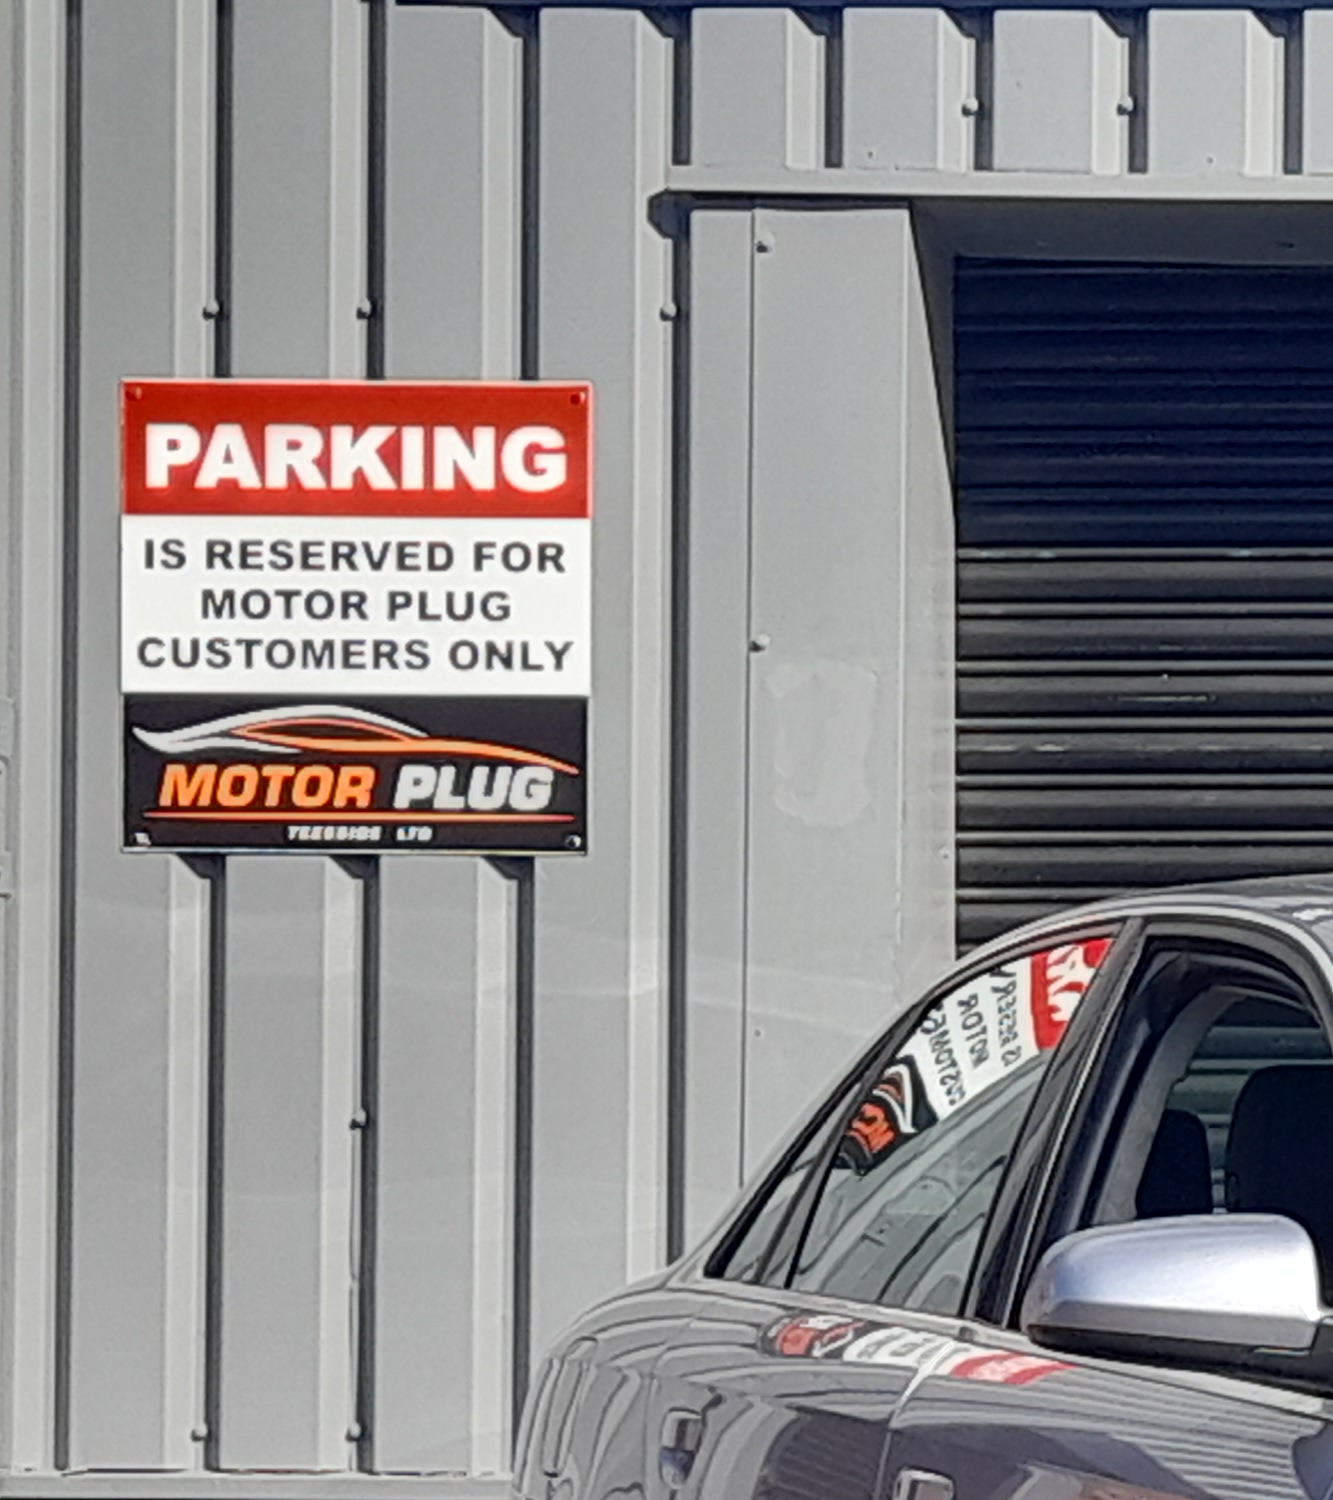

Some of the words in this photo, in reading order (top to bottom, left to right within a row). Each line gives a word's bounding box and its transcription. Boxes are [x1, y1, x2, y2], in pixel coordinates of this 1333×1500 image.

[146, 424, 566, 492] PARKING
[146, 540, 185, 569] IS
[207, 541, 453, 571] RESERVED
[475, 543, 564, 572] FOR
[203, 590, 367, 619] MOTOR
[389, 592, 509, 621] PLUG
[138, 638, 429, 669] CUSTOMERS
[450, 641, 571, 670] ONLY
[160, 764, 375, 808] MOTOR
[393, 766, 554, 810] PLUG
